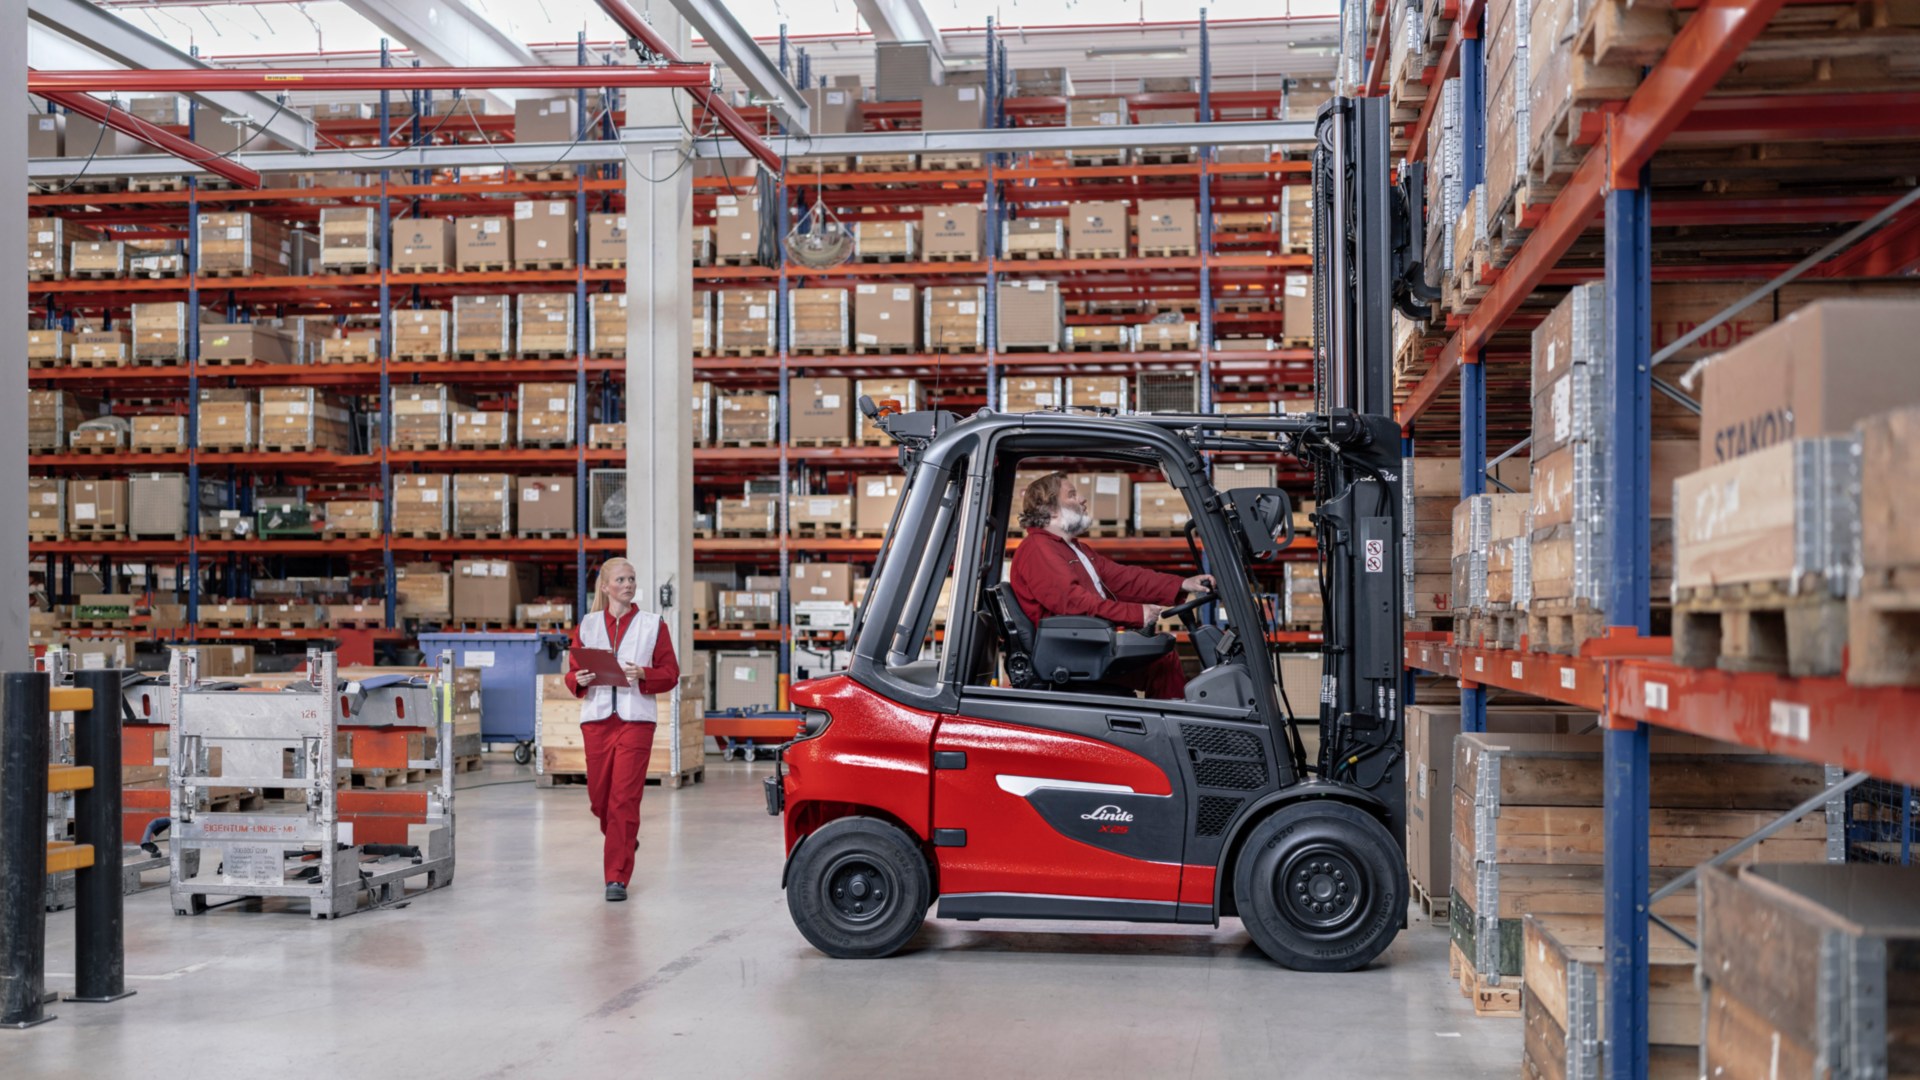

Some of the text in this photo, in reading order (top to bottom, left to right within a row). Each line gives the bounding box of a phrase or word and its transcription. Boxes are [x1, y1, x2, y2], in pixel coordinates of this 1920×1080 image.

[301, 710, 317, 719] 126
[1080, 804, 1134, 822] Linde
[1267, 826, 1294, 849] CS20
